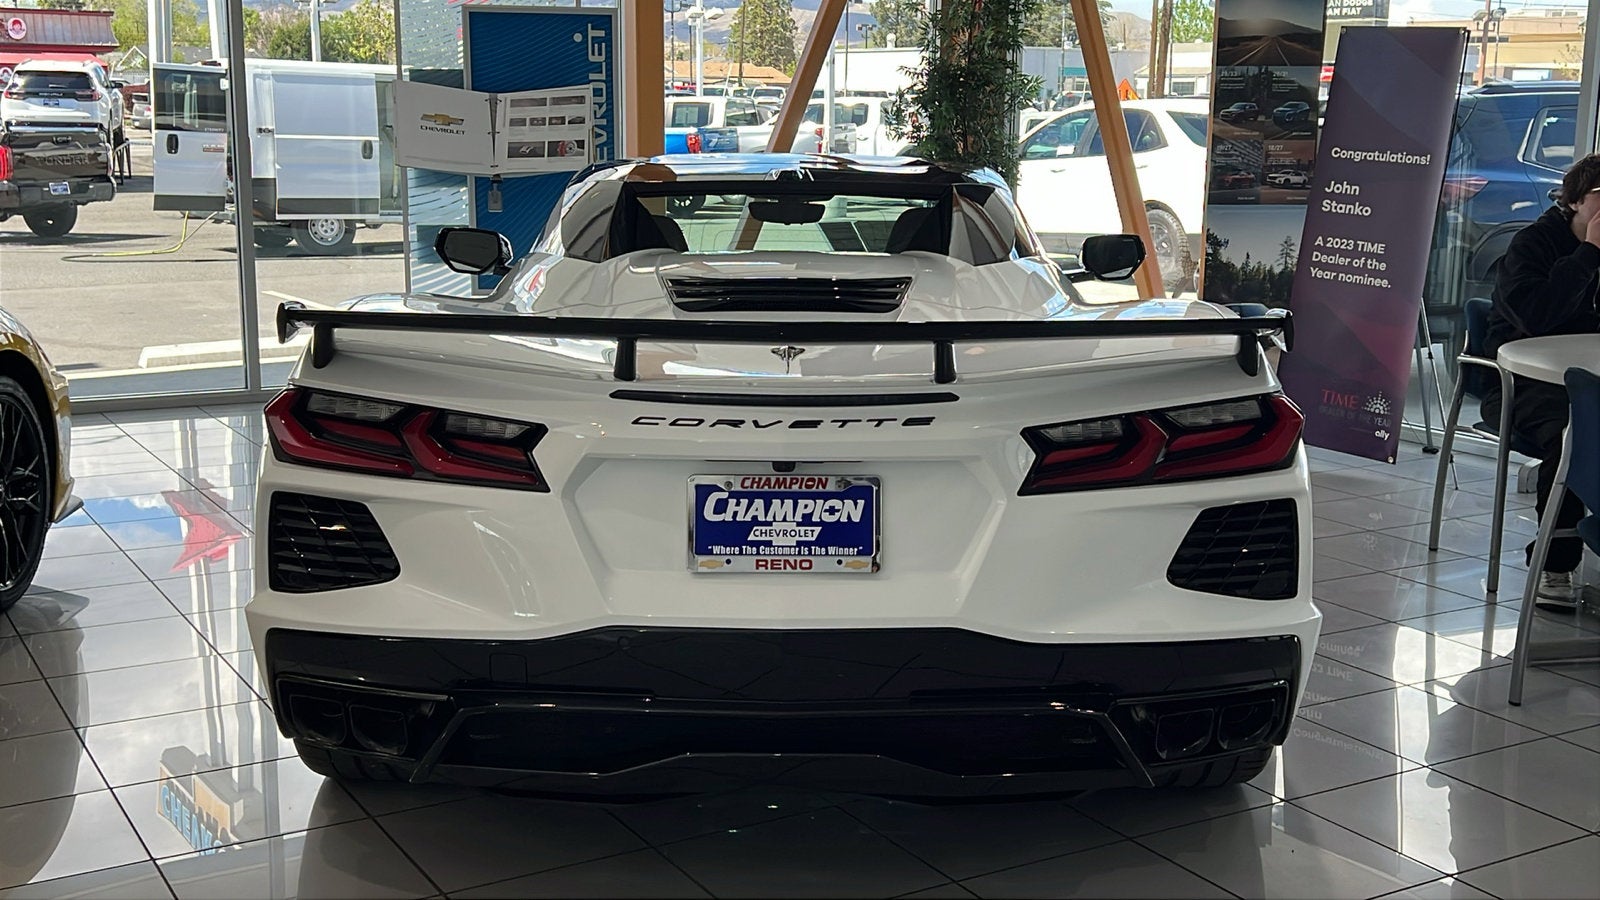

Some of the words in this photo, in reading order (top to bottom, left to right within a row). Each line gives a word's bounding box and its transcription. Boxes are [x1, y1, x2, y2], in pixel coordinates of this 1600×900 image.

[588, 23, 607, 164] EVROLET
[420, 125, 465, 135] CHEVROLET
[1331, 147, 1431, 165] Congratulations!
[1324, 181, 1360, 195] John
[1321, 199, 1372, 216] Stanko
[1314, 236, 1324, 246] A
[1326, 237, 1354, 250] 2023
[1356, 241, 1386, 254] TIME
[1312, 251, 1351, 265] Dealer
[1352, 257, 1366, 268] of
[1367, 258, 1387, 271] the
[1310, 267, 1337, 280] Year
[1338, 273, 1391, 288] nominee.
[1321, 389, 1359, 410] TIME
[631, 416, 936, 429] CORVETTE
[1373, 416, 1392, 428] YEAR
[1374, 430, 1390, 441] ally
[740, 477, 829, 490] CHAMPION
[703, 491, 865, 523] CHAMPION
[752, 528, 816, 538] CHEVROLET
[707, 545, 740, 555] "Where
[742, 545, 757, 555] The
[759, 545, 799, 555] Customer
[801, 545, 809, 555] Is
[811, 545, 826, 555] The
[828, 545, 863, 555] Winner"
[755, 558, 813, 571] RENO
